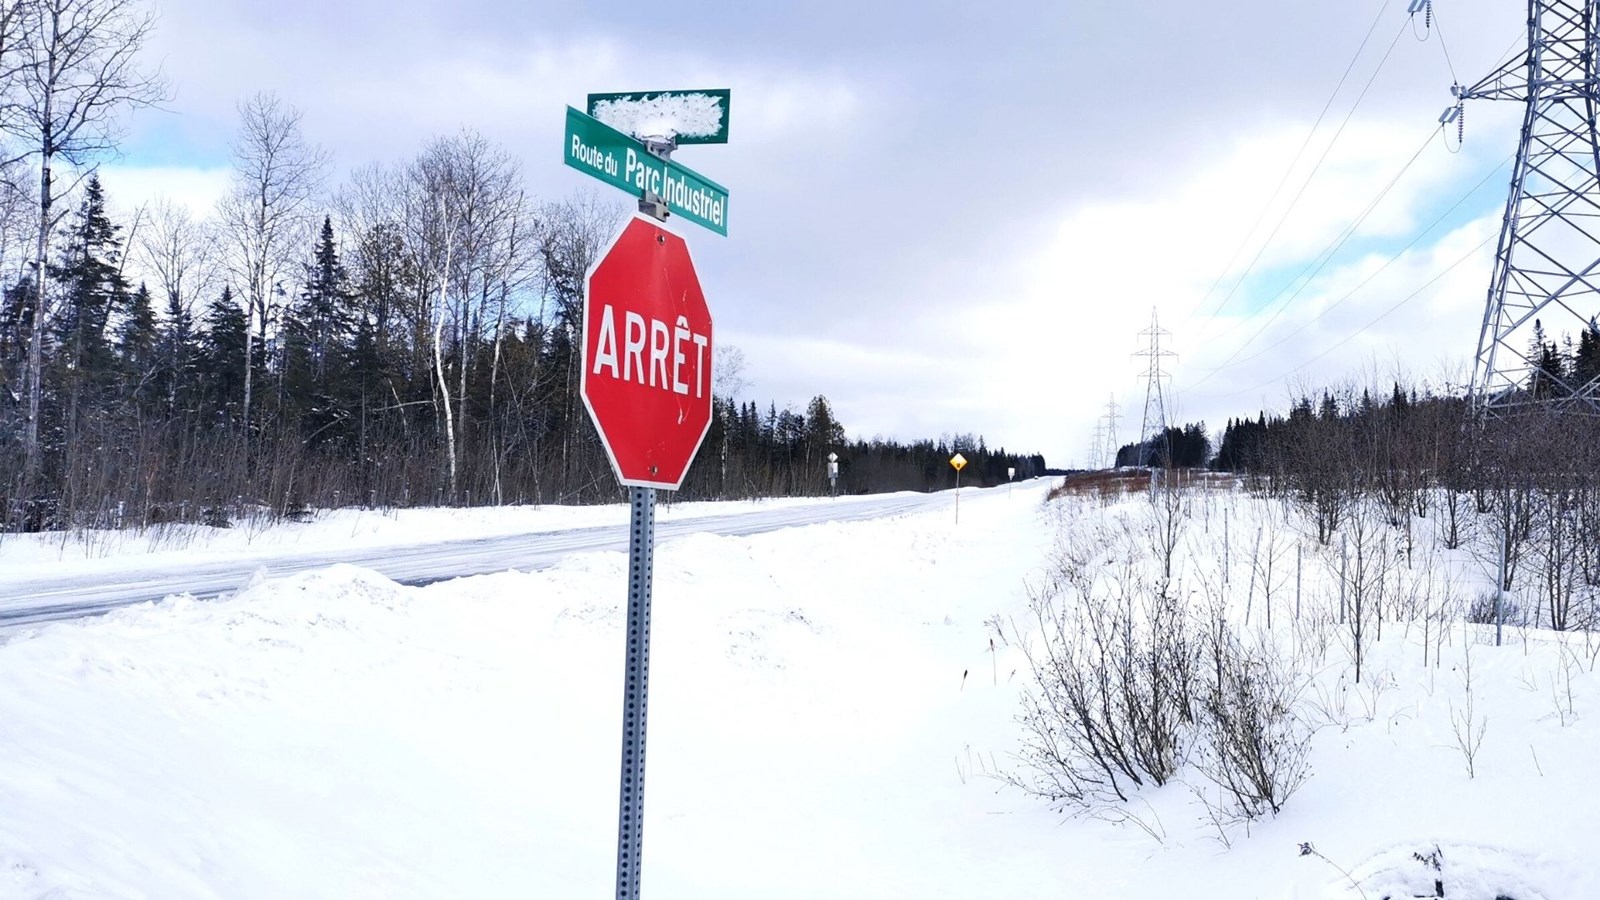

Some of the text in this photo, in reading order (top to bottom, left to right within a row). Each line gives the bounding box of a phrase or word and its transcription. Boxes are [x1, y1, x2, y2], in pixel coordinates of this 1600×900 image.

[571, 134, 724, 227] Route du Parc Industriel
[593, 304, 708, 399] ARRÊT
